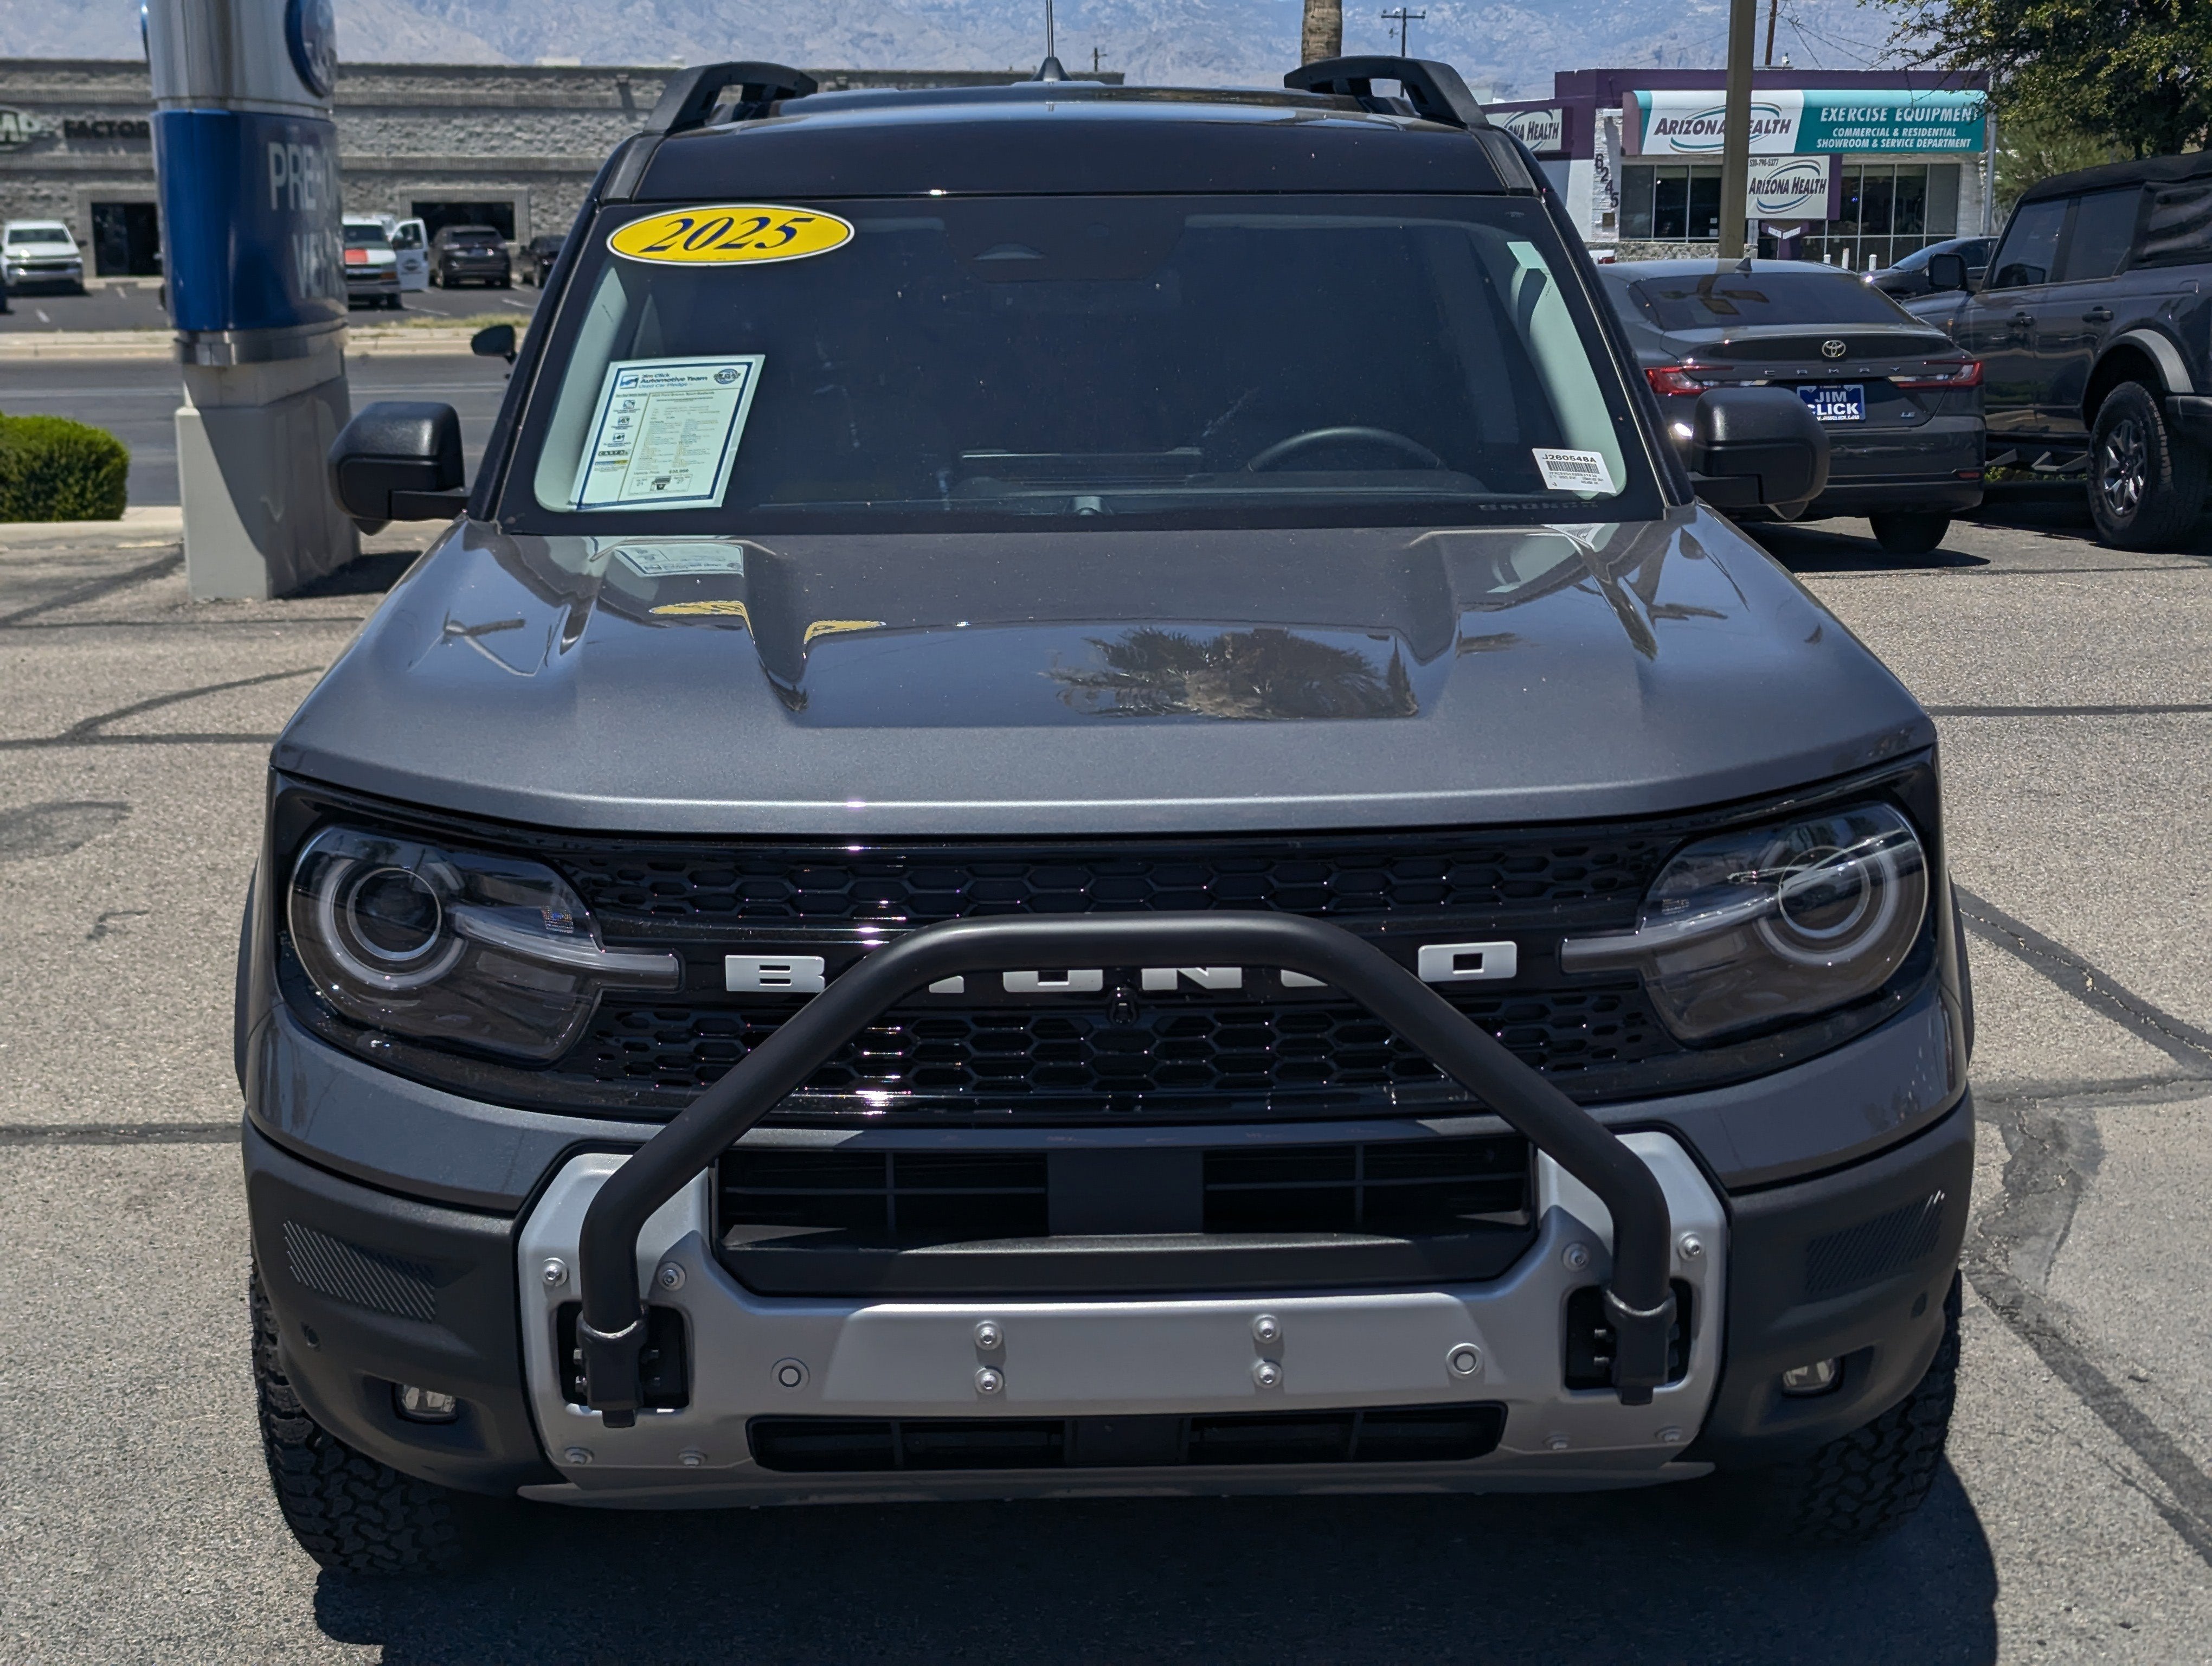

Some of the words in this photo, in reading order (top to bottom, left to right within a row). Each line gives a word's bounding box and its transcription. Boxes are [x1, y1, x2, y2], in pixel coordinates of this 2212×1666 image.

[1821, 107, 1888, 122] EXERCISE
[1526, 120, 1560, 141] HEALTH
[1832, 127, 1890, 137] COMMERCIAL
[1892, 128, 1900, 137] &
[1902, 127, 1957, 137] RESIDENTIAL
[1816, 138, 1869, 148] SHOWROOM
[1872, 139, 1878, 148] &
[1881, 138, 1914, 148] SERVICE
[1916, 138, 1972, 148] DEPARTMENT
[1595, 153, 1619, 208] 6245
[1748, 177, 1790, 195] ARIZONA
[1791, 176, 1828, 195] HEALTH
[638, 216, 816, 253] 2025
[1814, 391, 1847, 403] JIM
